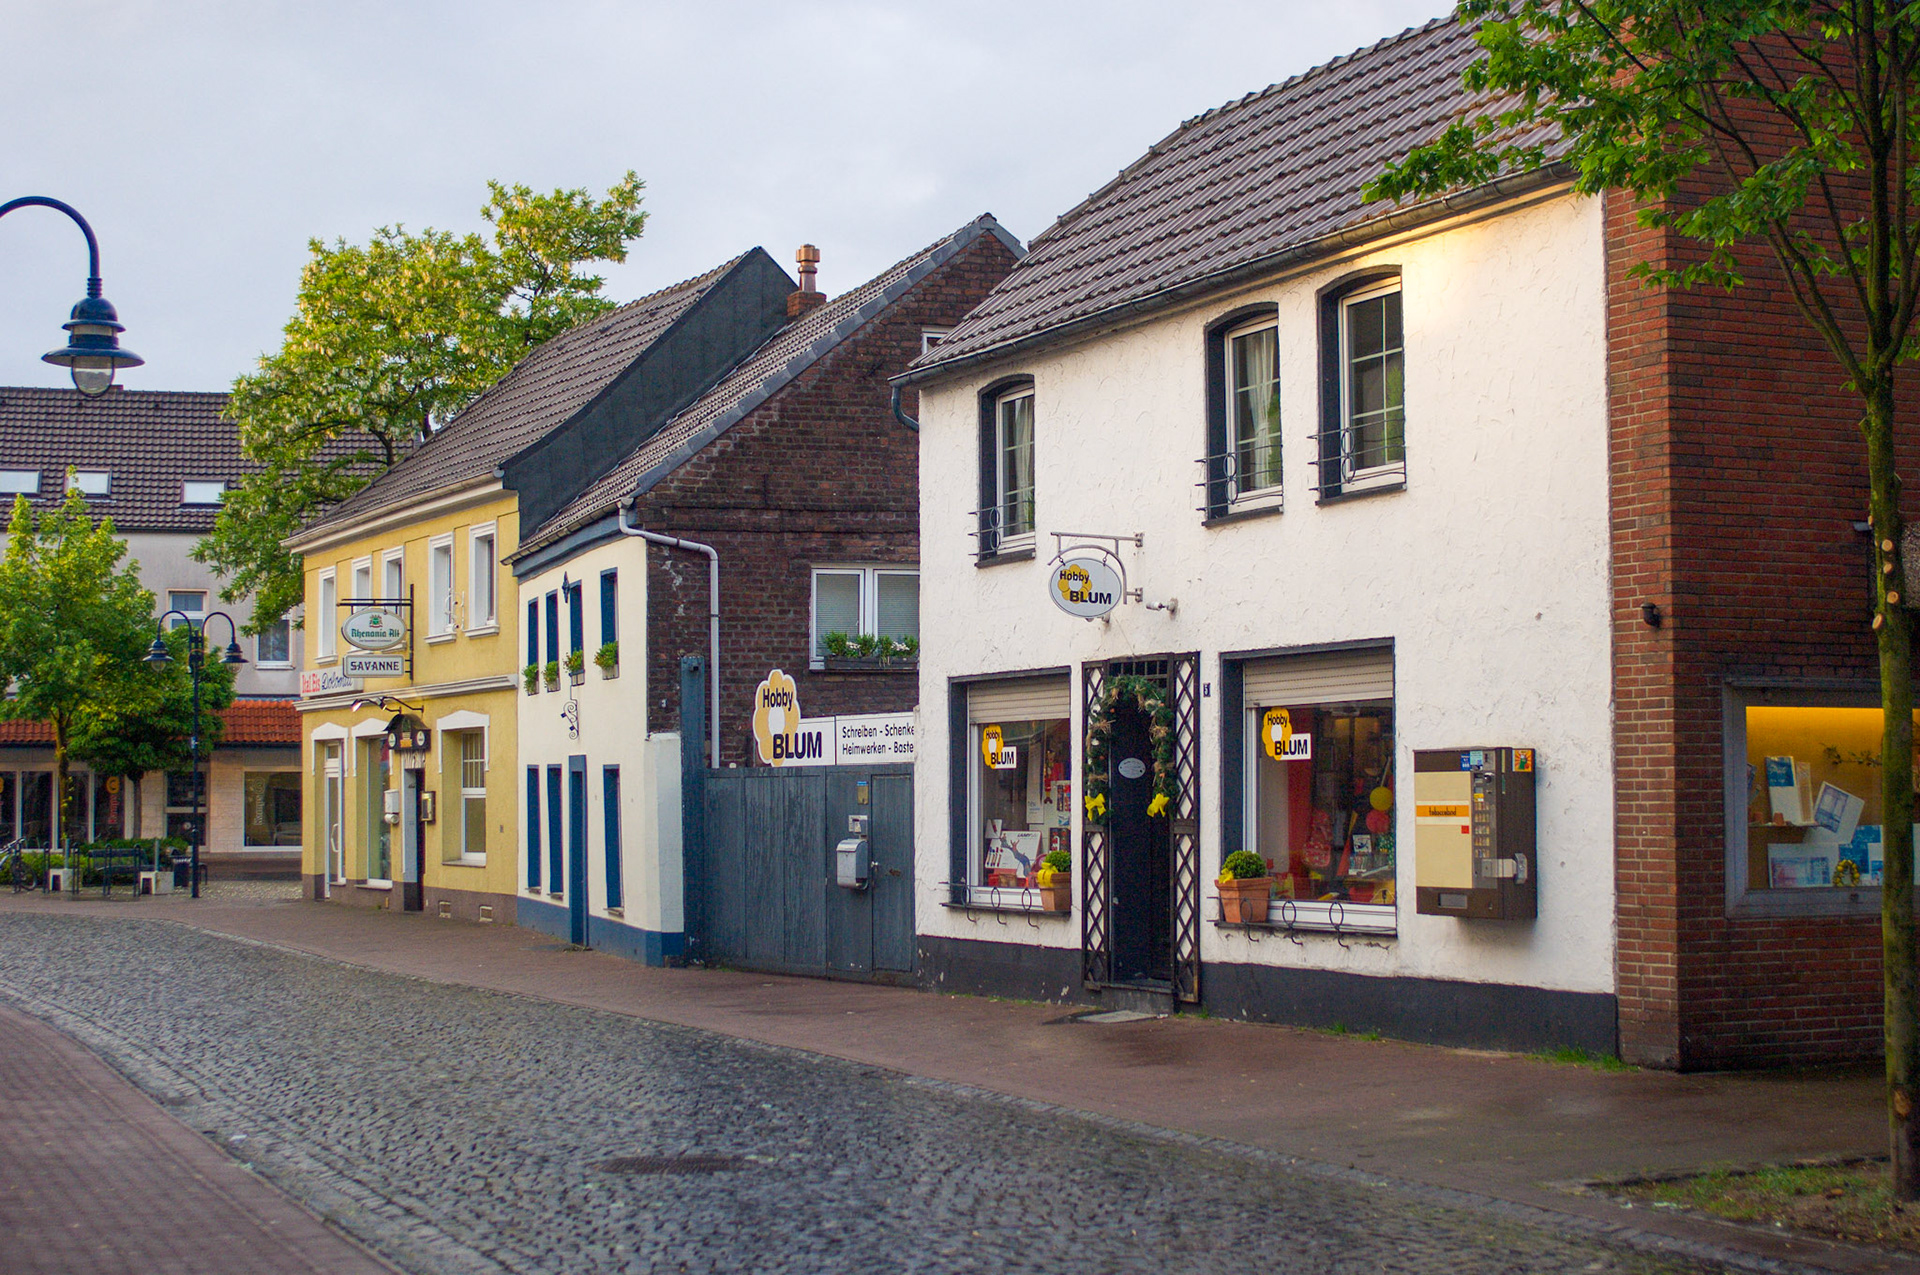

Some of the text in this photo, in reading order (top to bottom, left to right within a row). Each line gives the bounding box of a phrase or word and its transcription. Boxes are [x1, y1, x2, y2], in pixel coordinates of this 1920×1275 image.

[1060, 570, 1090, 584] Hobby
[1070, 591, 1112, 605] BLUM
[351, 628, 400, 639] Rhenania Alt
[350, 661, 400, 671] SAVANNE
[762, 687, 793, 712] Hobby
[1267, 713, 1288, 728] Hobby
[842, 724, 878, 739] Schreiben
[986, 729, 1001, 742] Hobby
[772, 731, 822, 760] BLUM
[842, 742, 886, 755] Heimwerken
[1274, 739, 1308, 756] BLUM
[991, 751, 1015, 765] BLUM
